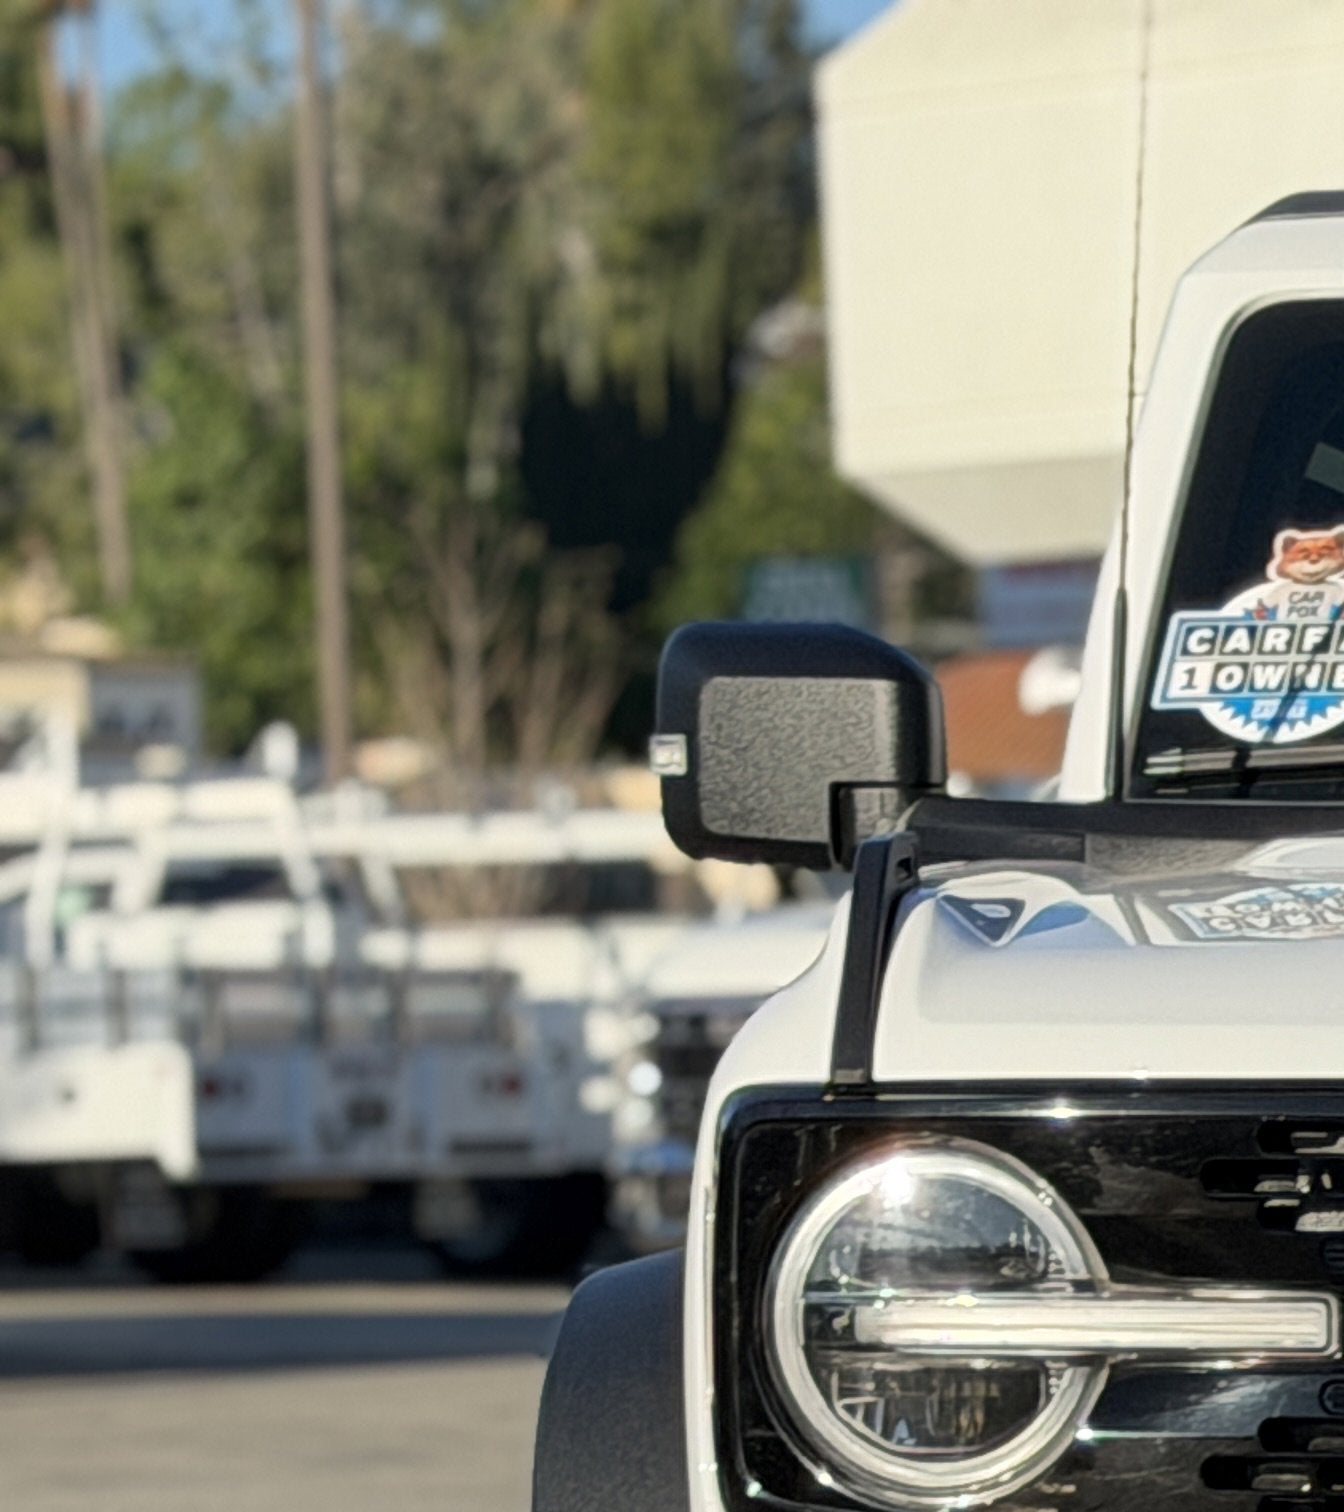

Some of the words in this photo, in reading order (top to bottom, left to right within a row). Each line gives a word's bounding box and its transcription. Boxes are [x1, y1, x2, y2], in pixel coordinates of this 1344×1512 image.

[1288, 591, 1325, 604] CAR
[1287, 605, 1321, 618] FOX
[1178, 666, 1198, 691] 1
